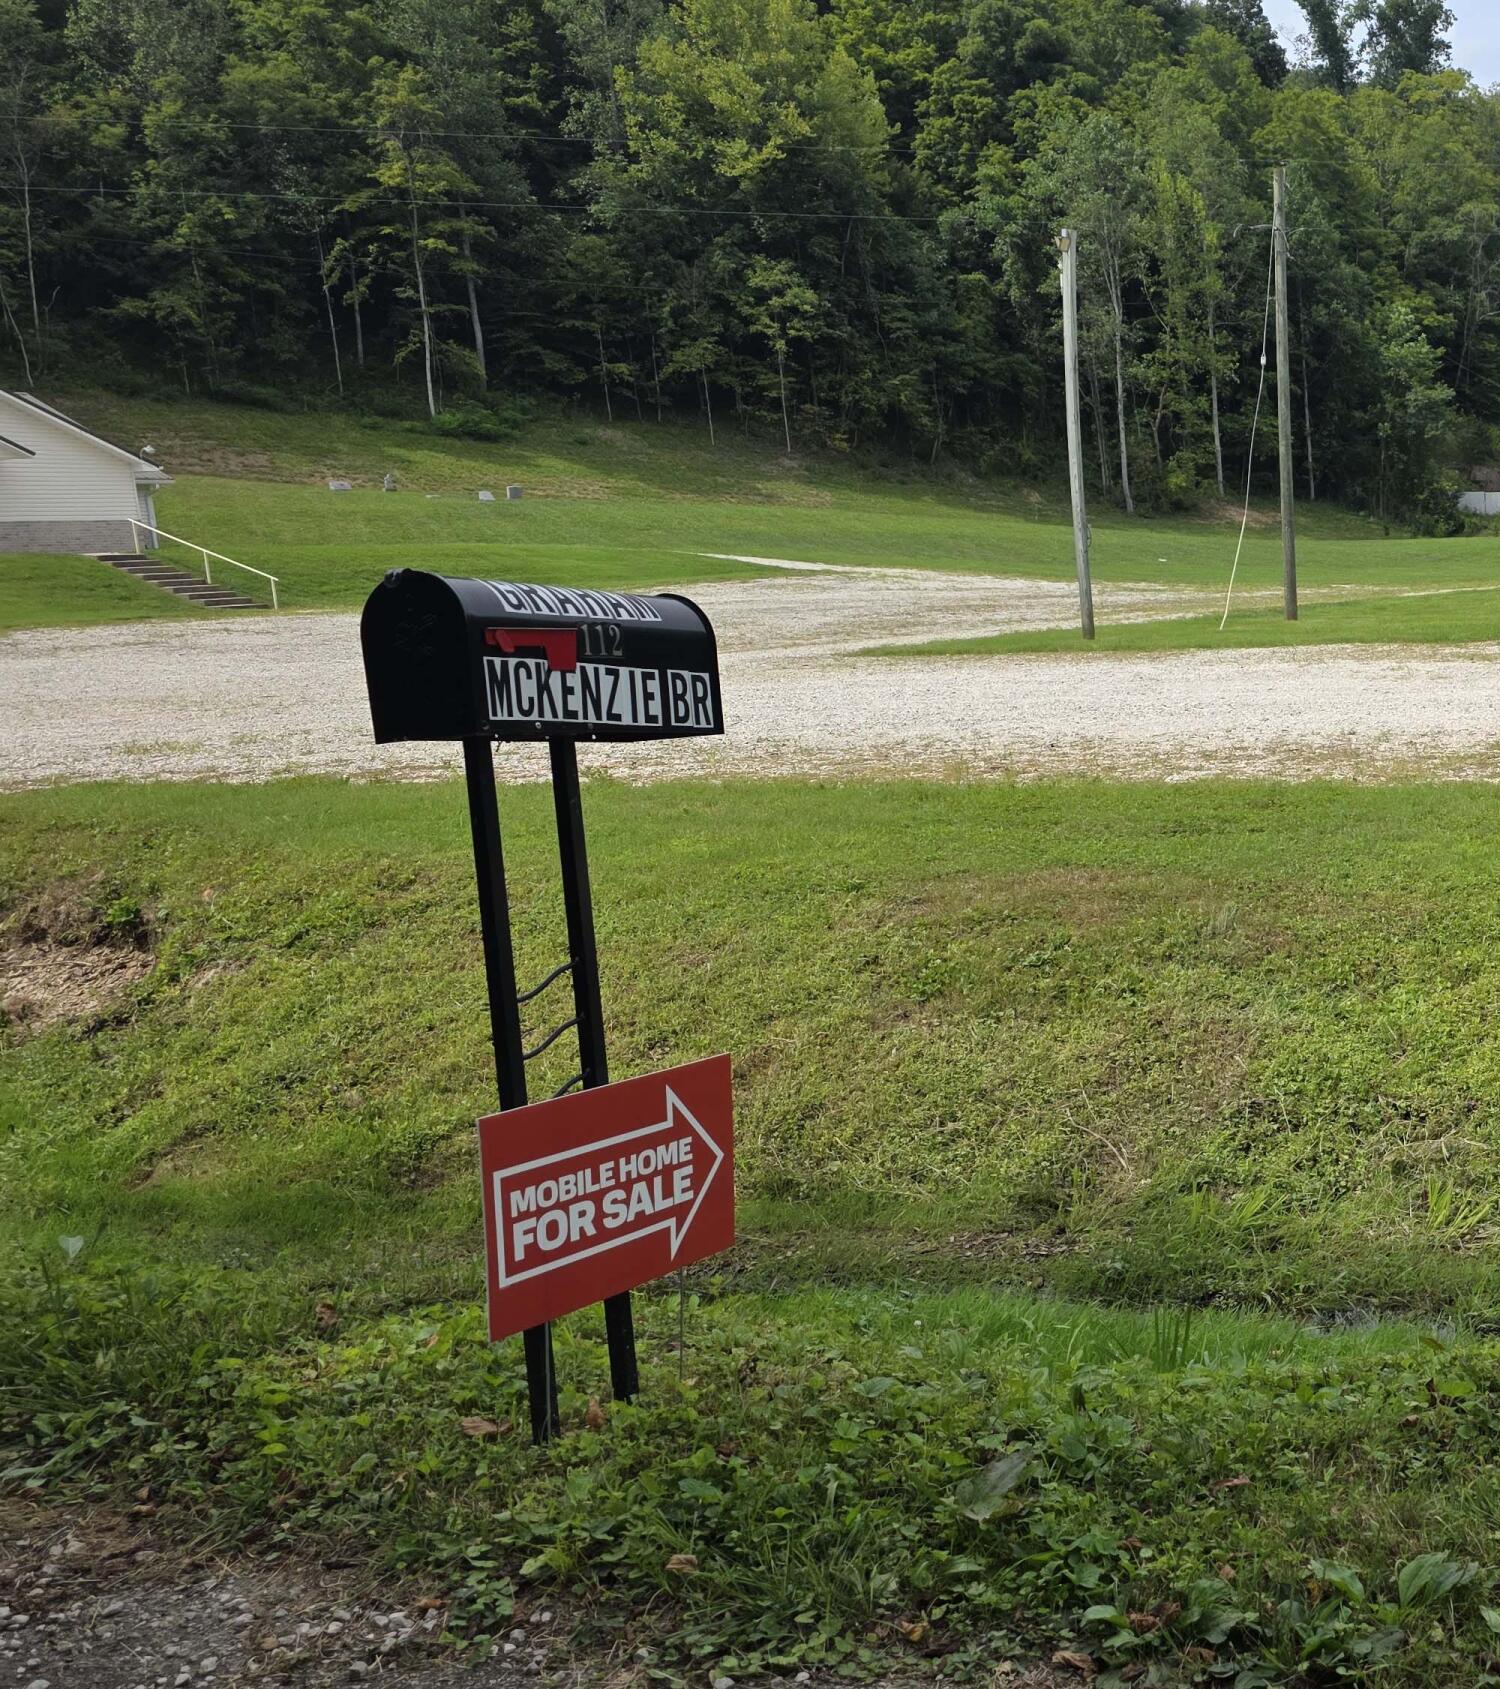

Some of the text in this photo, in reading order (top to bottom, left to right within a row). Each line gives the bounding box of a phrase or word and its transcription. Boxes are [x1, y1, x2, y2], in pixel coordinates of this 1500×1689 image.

[580, 623, 623, 656] 112
[487, 660, 711, 726] MCKENZIE BR
[510, 1137, 693, 1217] MOBILE HOME
[512, 1165, 694, 1262] FOR SALE
